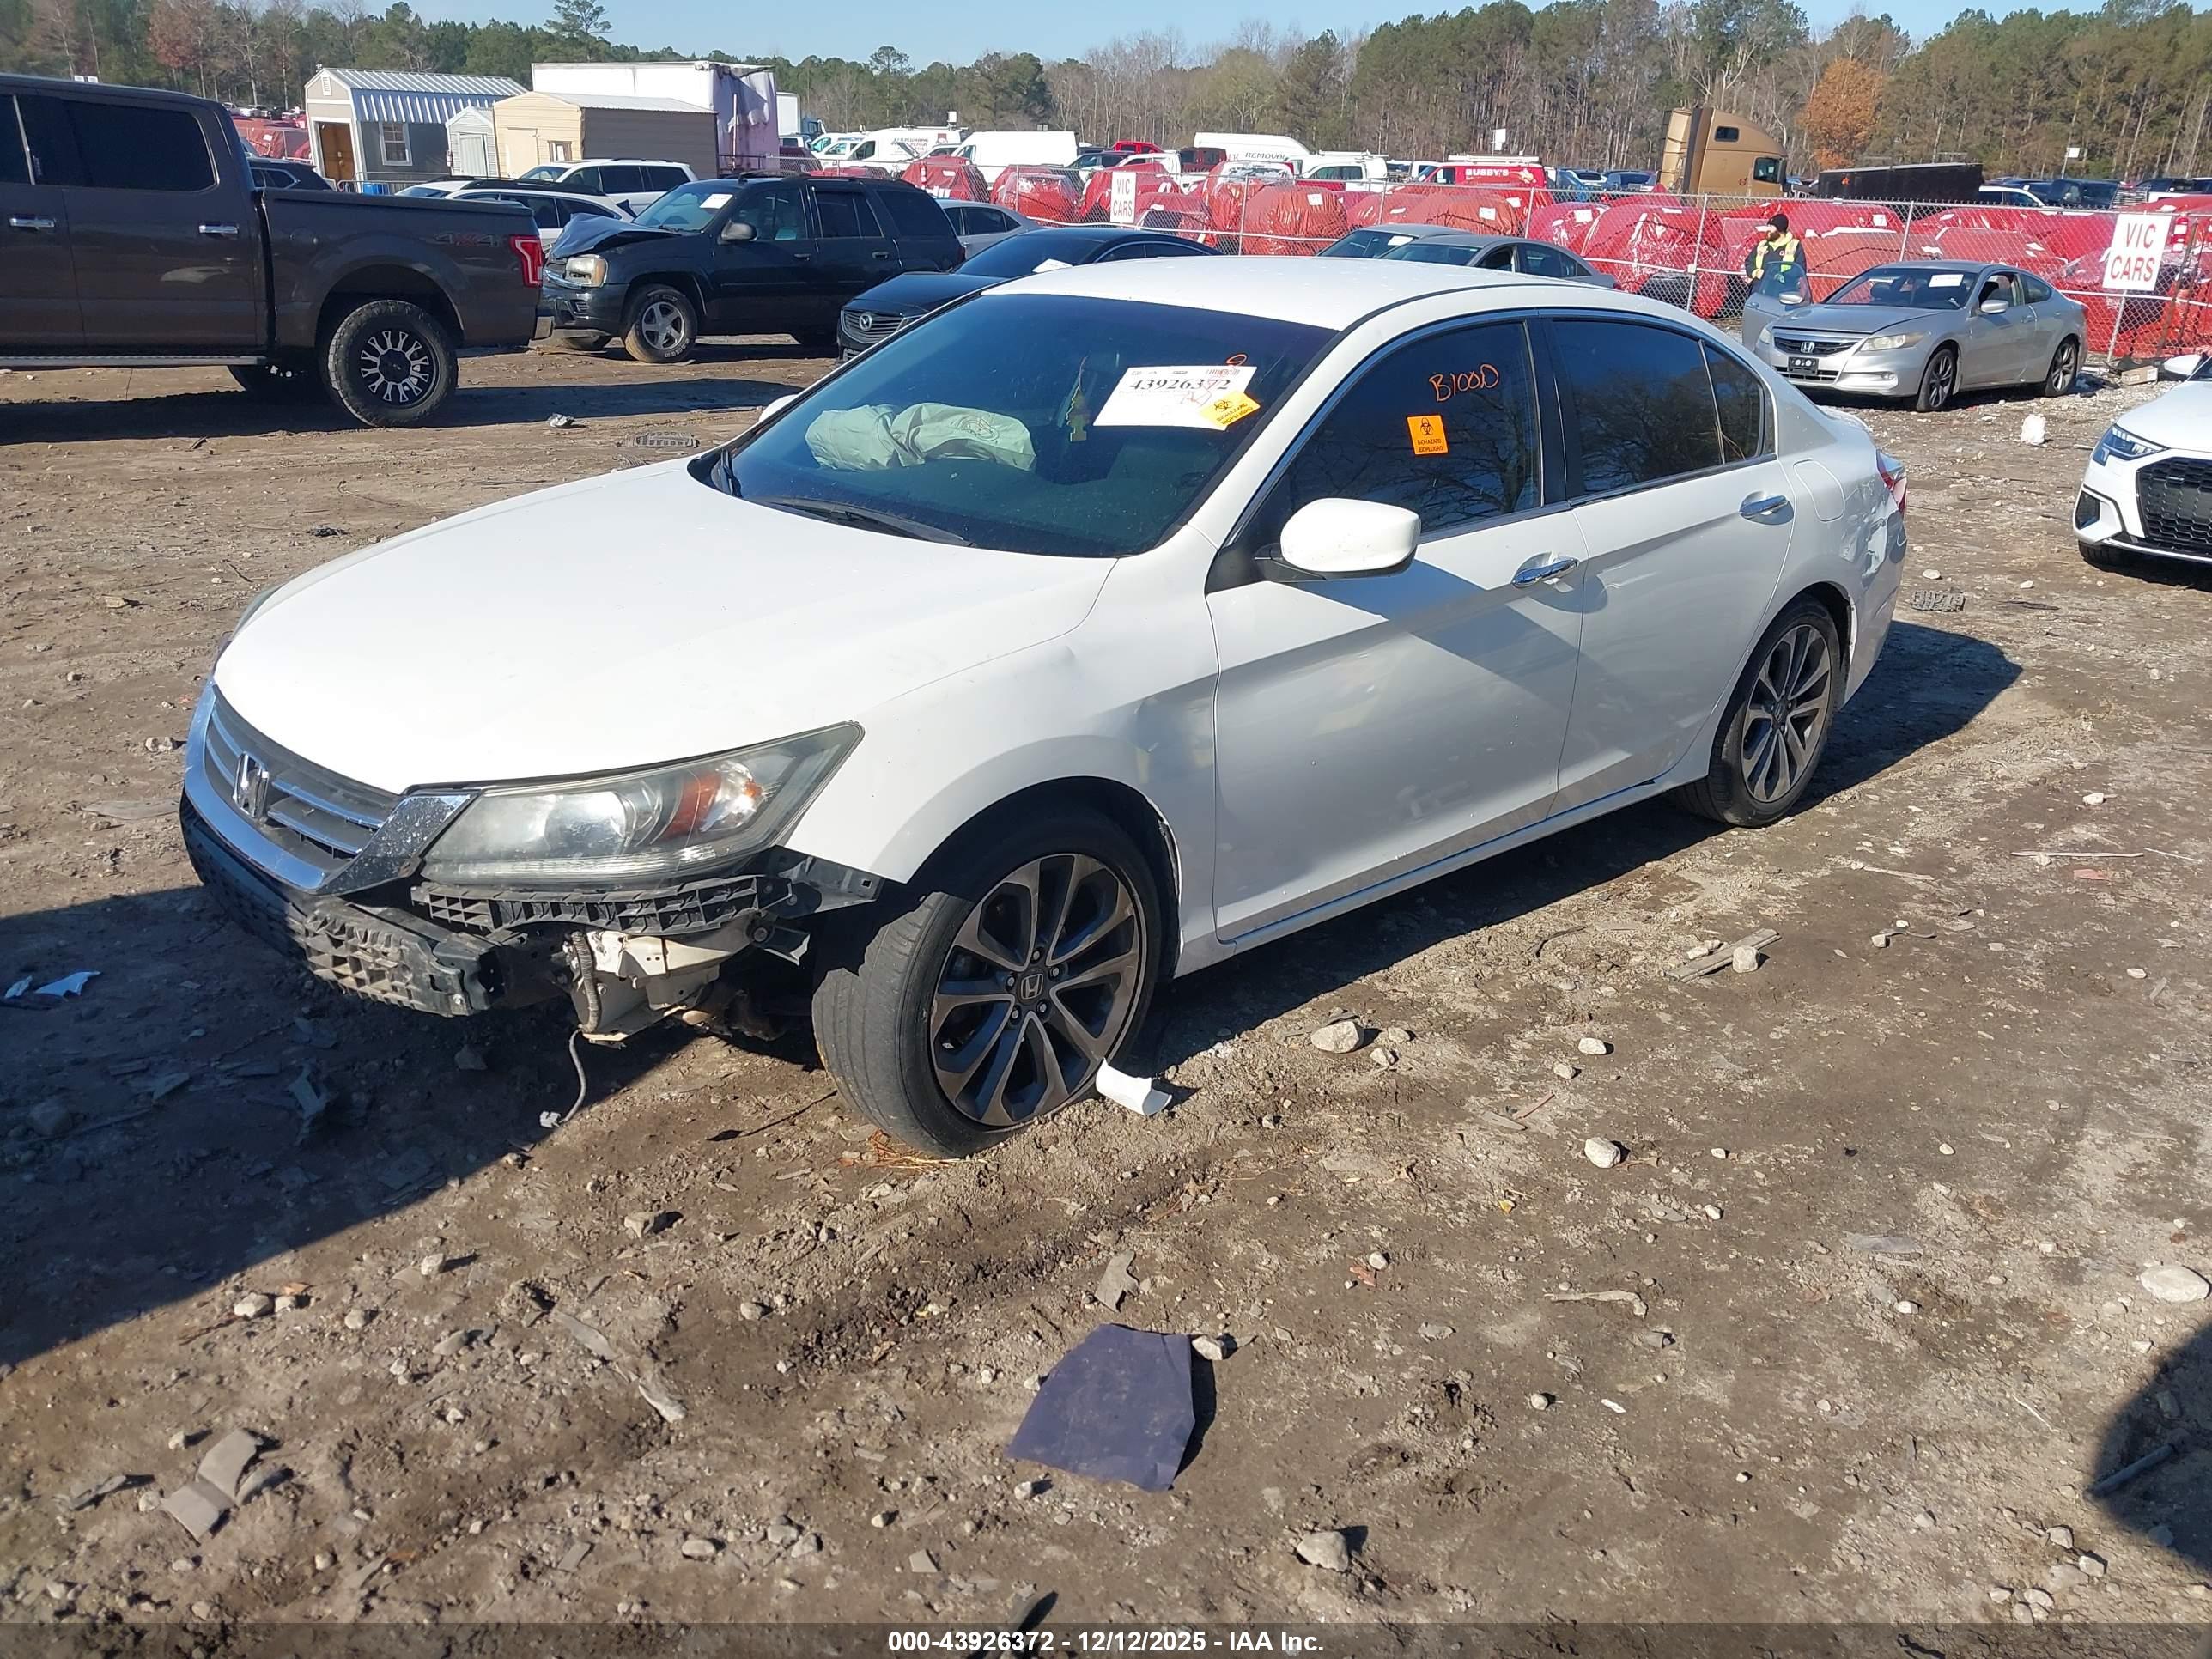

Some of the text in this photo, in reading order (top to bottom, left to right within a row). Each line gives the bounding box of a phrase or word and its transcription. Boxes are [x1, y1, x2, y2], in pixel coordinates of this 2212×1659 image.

[1116, 178, 1130, 195] VIC
[1113, 199, 1133, 216] CARS
[2125, 222, 2156, 249] VIC
[2110, 255, 2155, 282] CARS
[1129, 378, 1231, 390] 43926372
